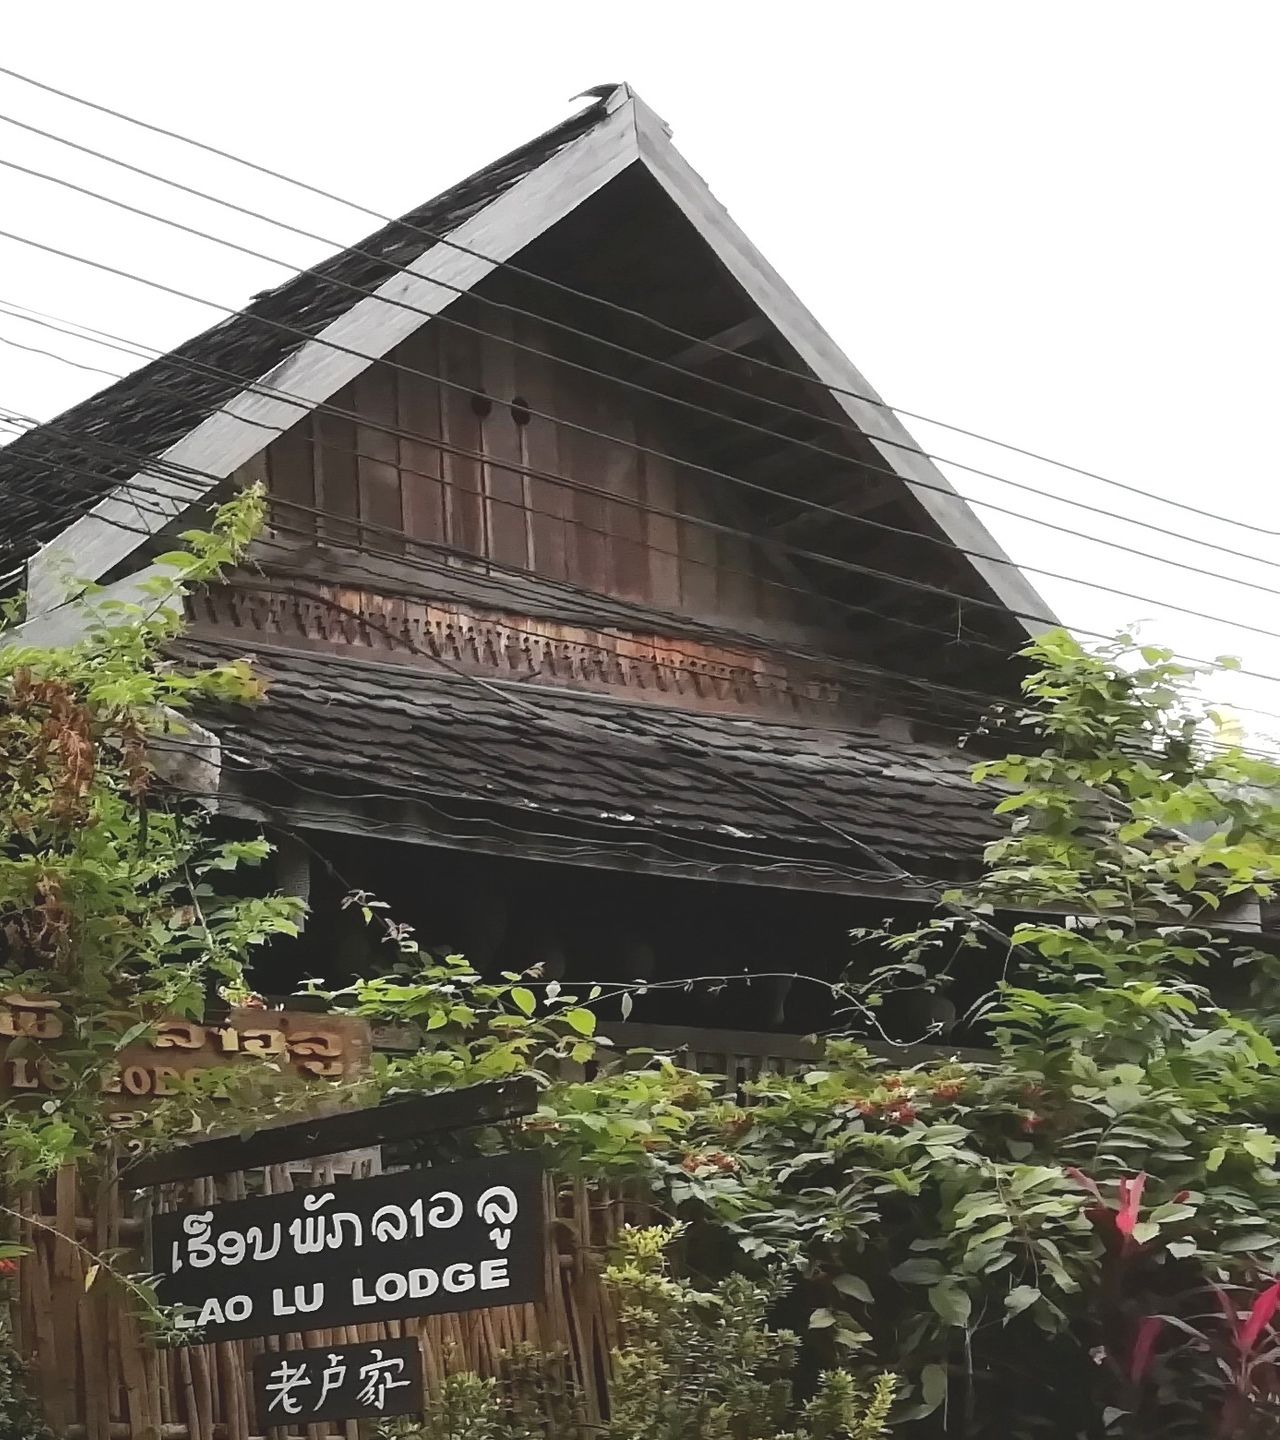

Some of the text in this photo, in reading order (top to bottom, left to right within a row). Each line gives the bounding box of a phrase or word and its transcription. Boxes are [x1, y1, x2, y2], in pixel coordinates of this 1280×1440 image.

[173, 1257, 510, 1329] LAO LU LODGE
